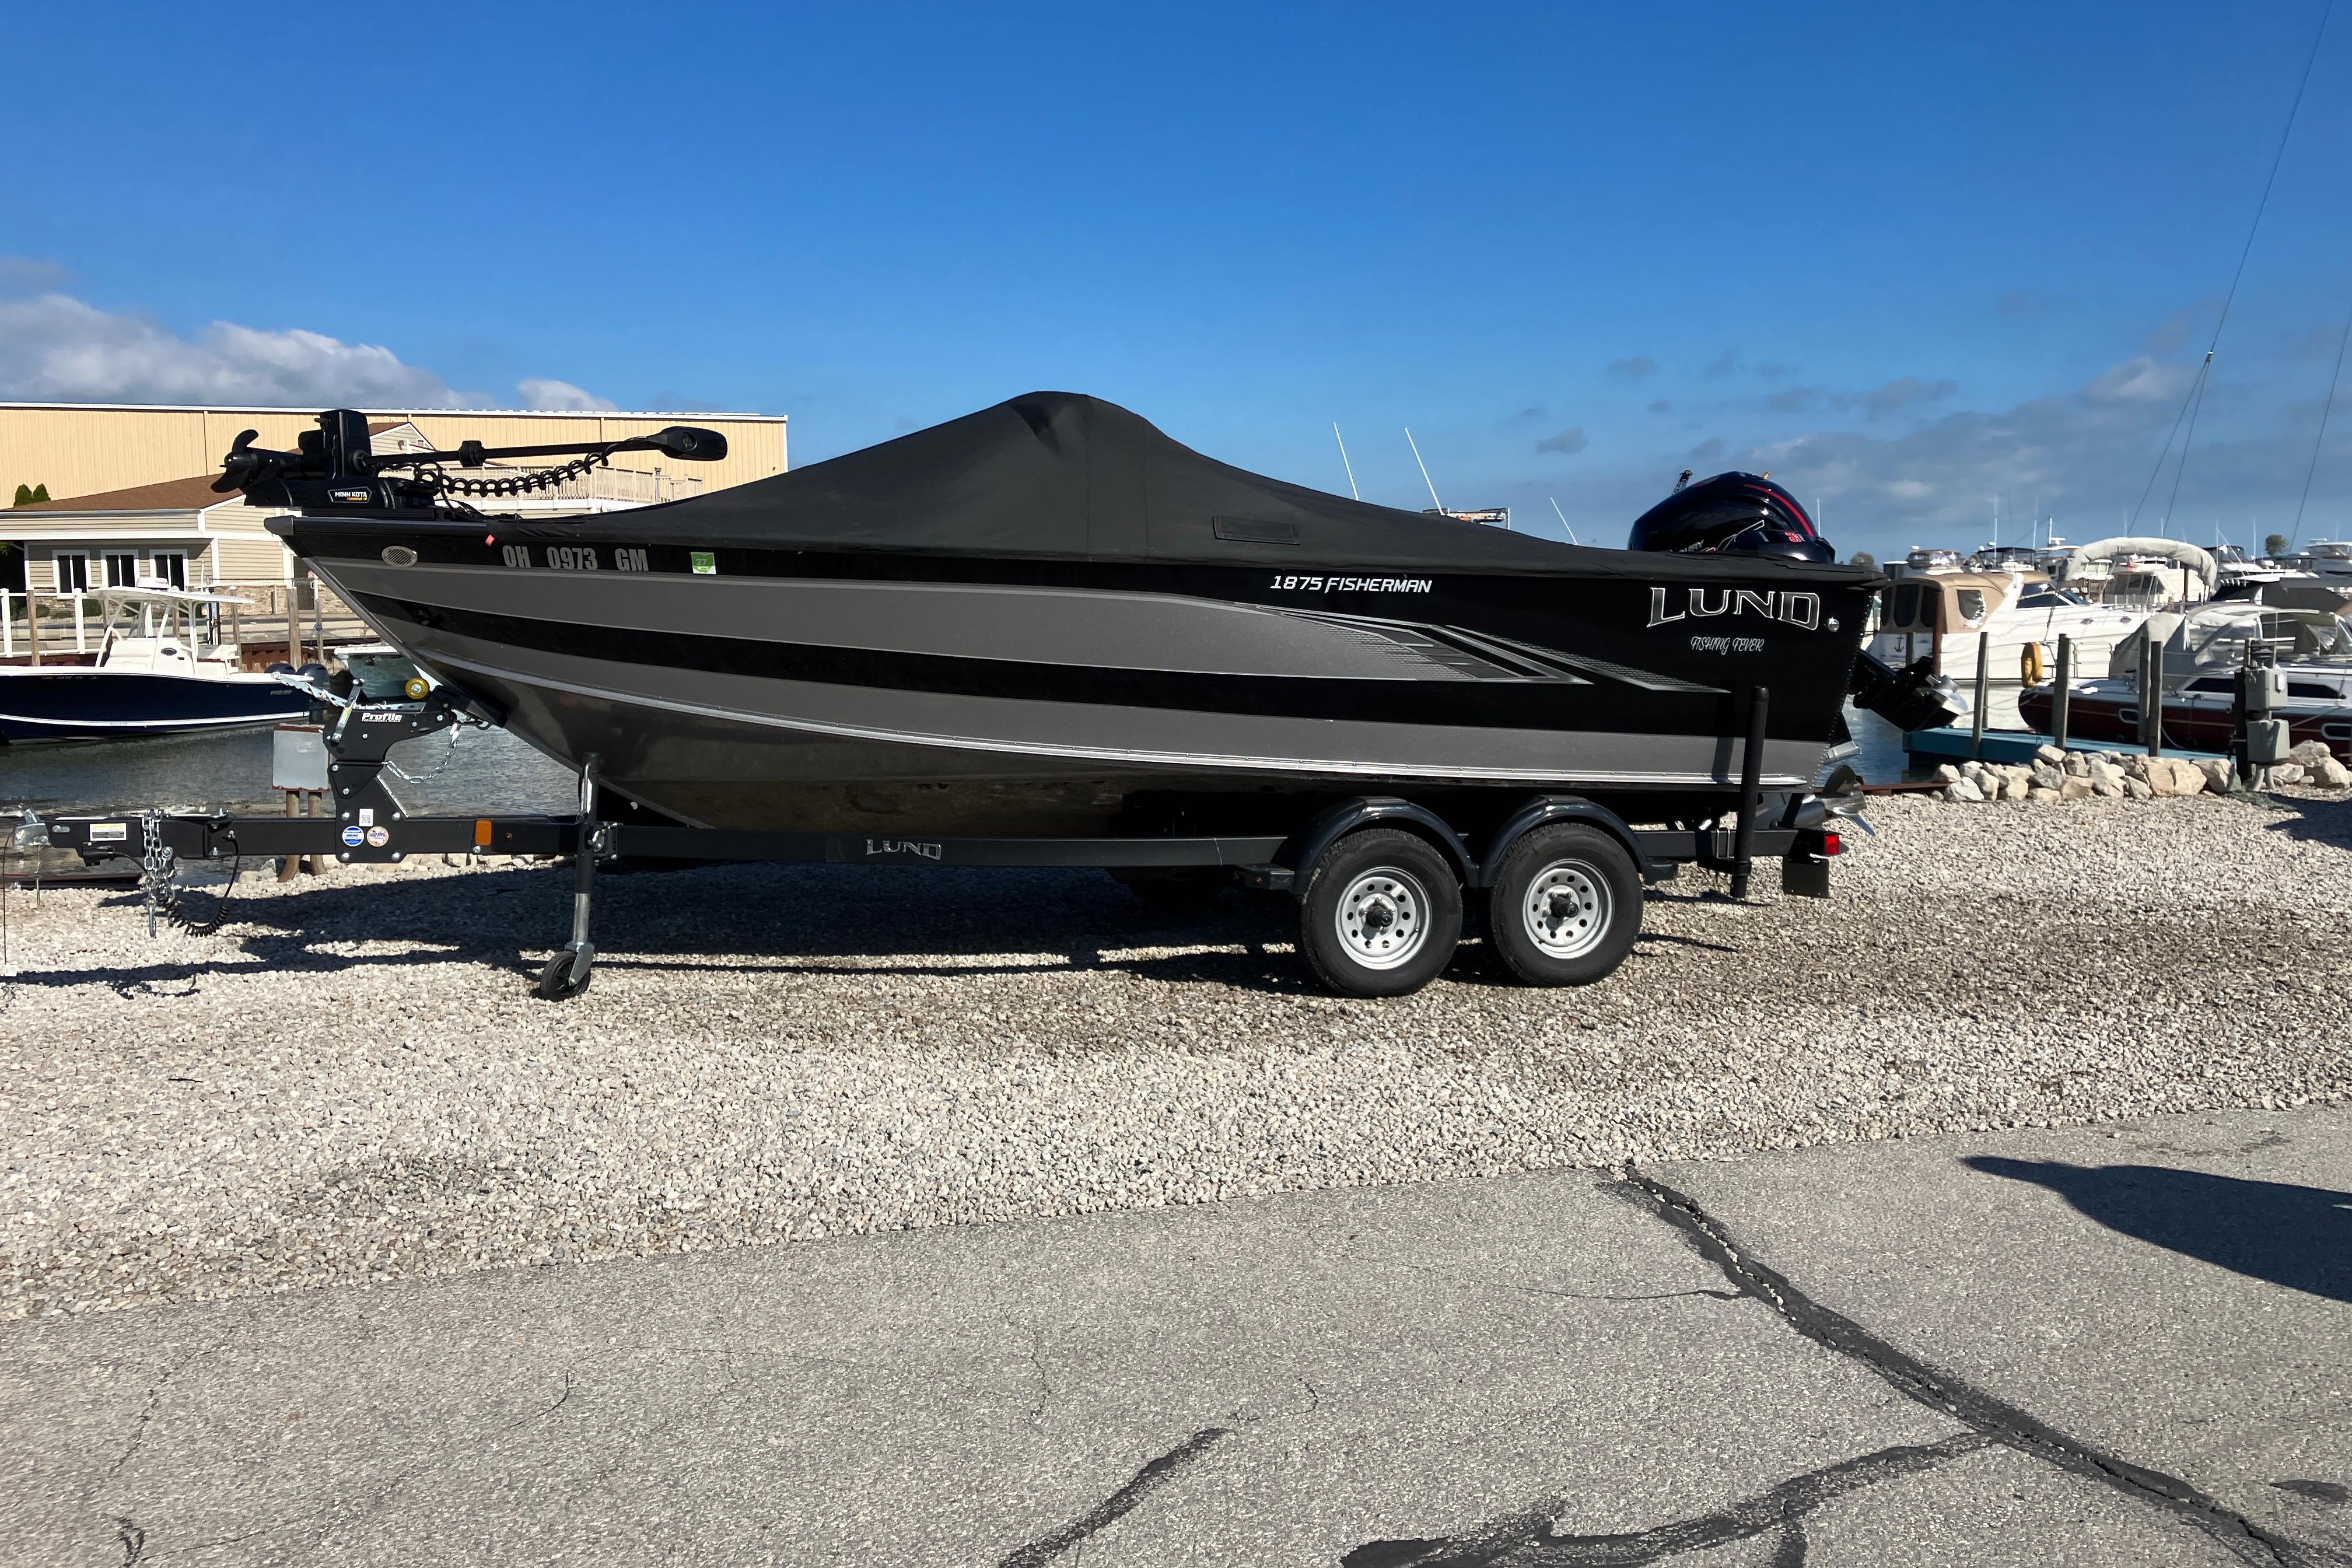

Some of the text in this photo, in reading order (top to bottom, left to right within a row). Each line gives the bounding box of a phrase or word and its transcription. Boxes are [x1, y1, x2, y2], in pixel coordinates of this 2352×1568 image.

[502, 545, 649, 572] OH 0973 GM
[1270, 575, 1433, 594] 1875 FISHERMAN
[1646, 587, 1820, 631] LUND
[1691, 636, 1765, 655] FISHING FEVER
[362, 712, 402, 722] Profile
[865, 839, 942, 861] LUND
